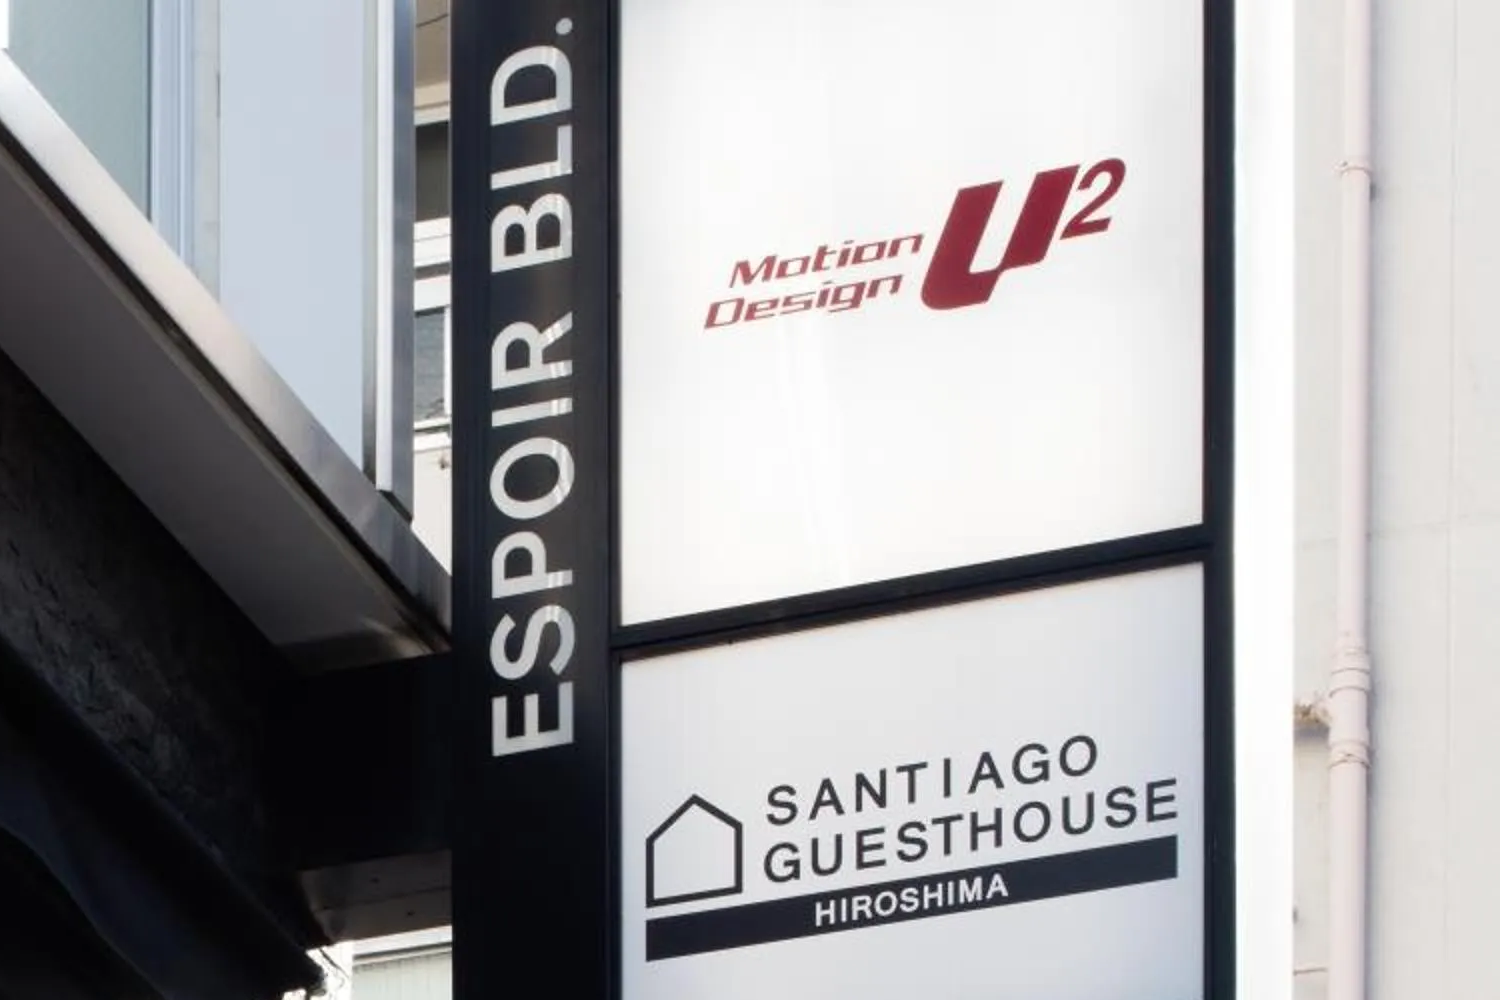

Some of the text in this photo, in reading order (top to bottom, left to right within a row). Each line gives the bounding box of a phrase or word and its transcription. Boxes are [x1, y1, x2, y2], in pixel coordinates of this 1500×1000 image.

[729, 233, 924, 289] Motion
[703, 273, 904, 330] Design
[490, 17, 575, 757] ESPOIR BLD.
[766, 735, 1098, 826] SANTIAGO
[763, 778, 1178, 883] GUESTHOUSE
[815, 873, 1009, 927] HIROSHIMA
